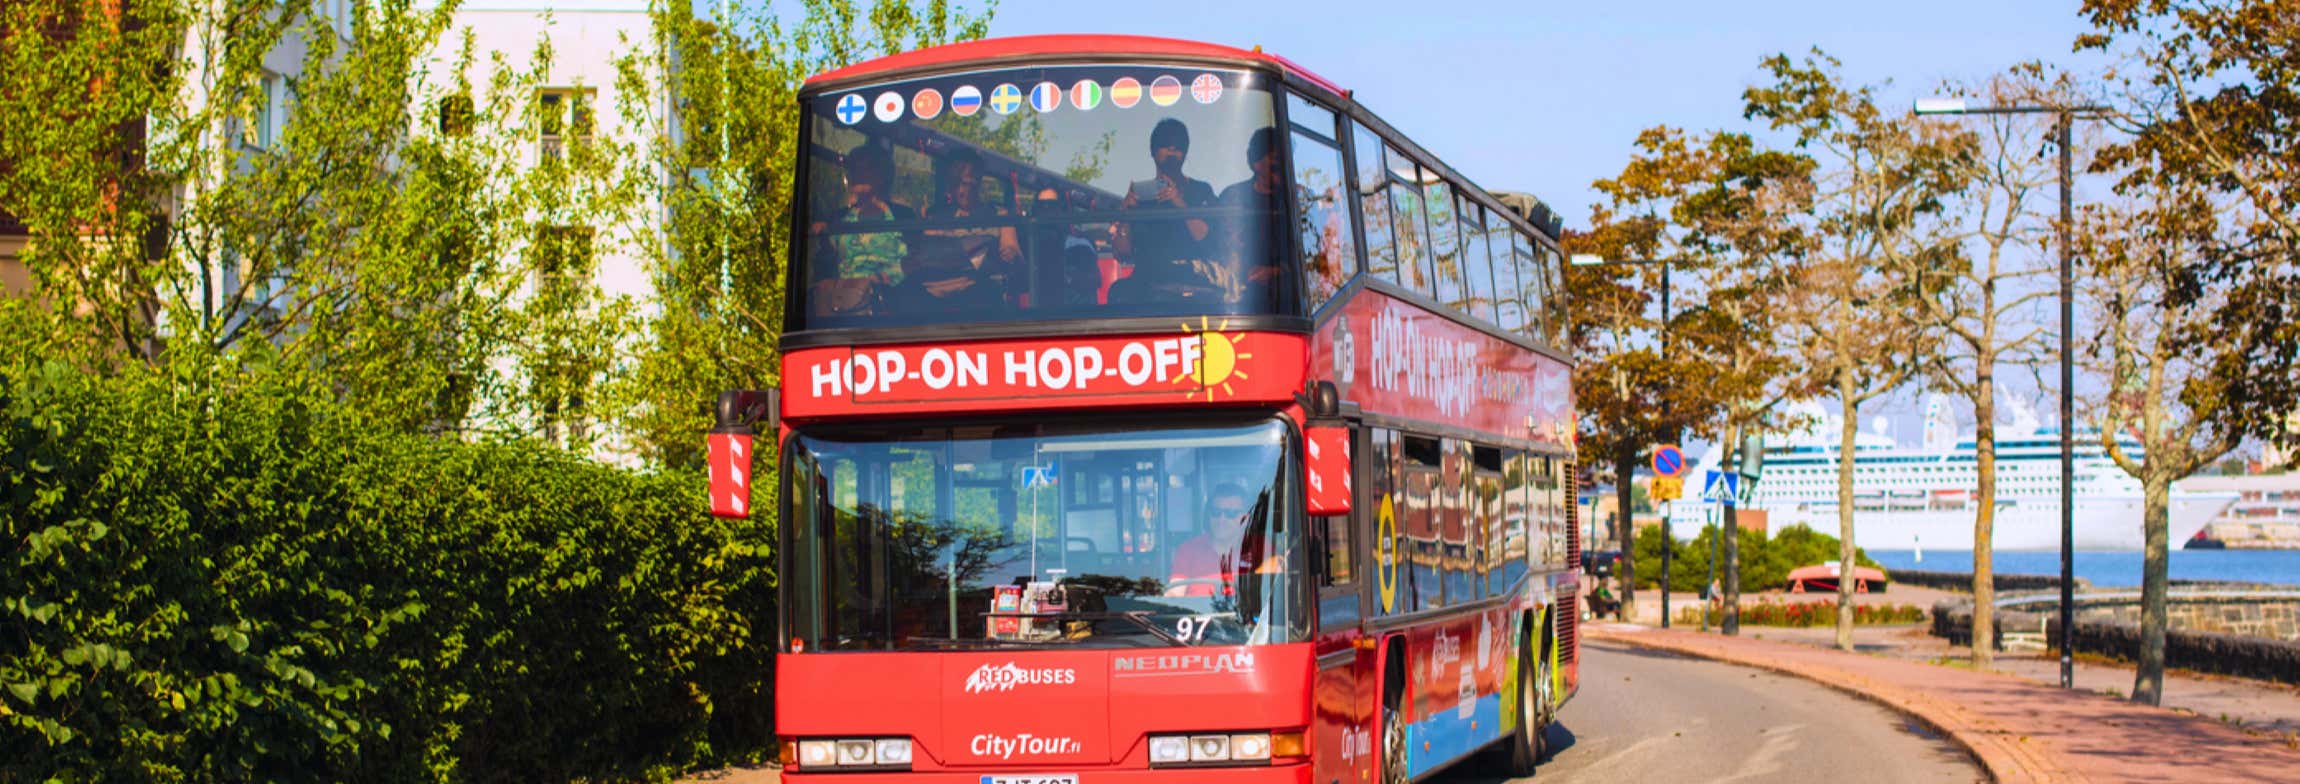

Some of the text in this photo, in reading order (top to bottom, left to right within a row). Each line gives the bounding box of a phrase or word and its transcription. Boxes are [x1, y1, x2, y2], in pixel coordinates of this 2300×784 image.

[811, 335, 1204, 398] HOP-ON HOP-OFF
[1371, 306, 1426, 399] HOP-ON
[1428, 336, 1477, 417] HOP-OFF
[1176, 615, 1212, 643] 97
[1114, 653, 1254, 673] NEOPLAN
